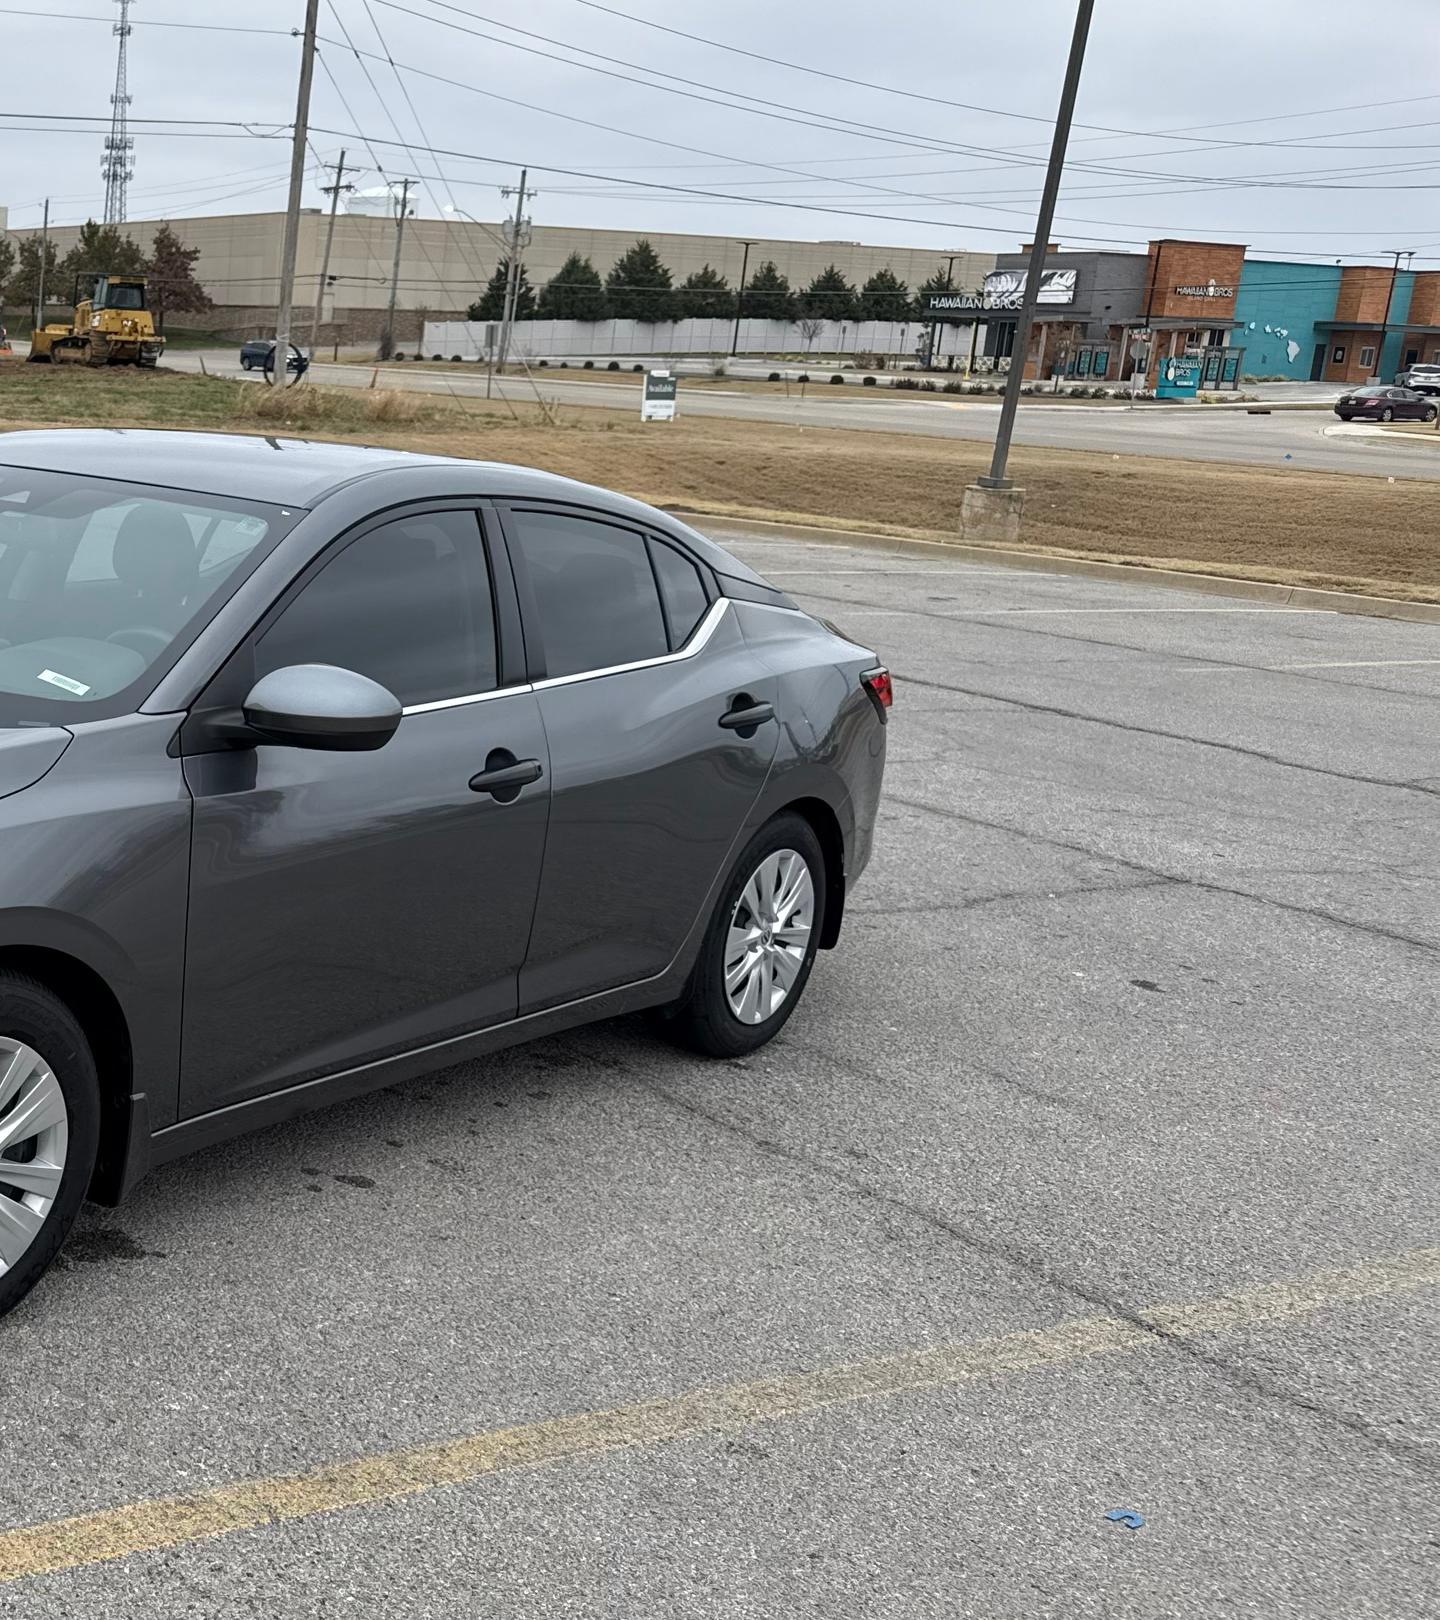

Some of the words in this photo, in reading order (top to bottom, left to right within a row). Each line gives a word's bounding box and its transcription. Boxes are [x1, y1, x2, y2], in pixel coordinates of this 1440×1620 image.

[1214, 287, 1233, 297] BROS
[929, 297, 982, 309] HAWAIIAN
[991, 297, 1024, 310] BROS
[1175, 368, 1191, 377] BROS
[648, 384, 674, 392] Available
